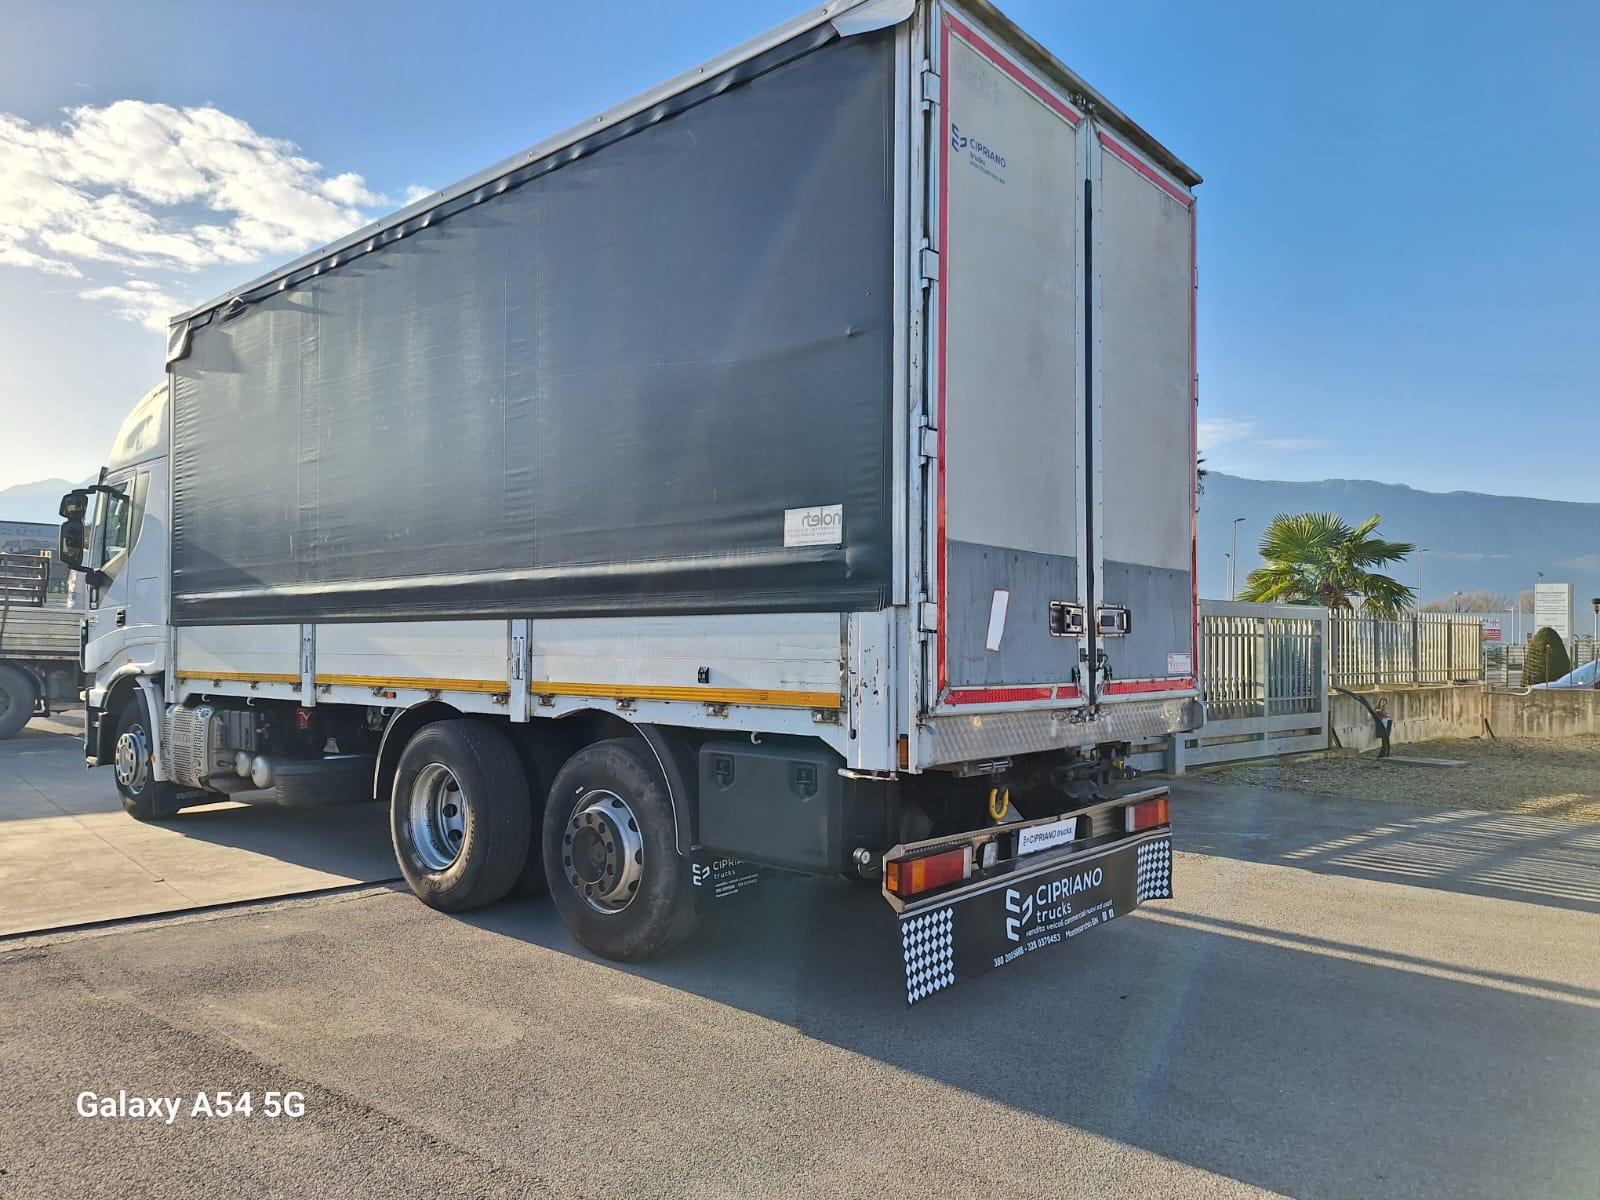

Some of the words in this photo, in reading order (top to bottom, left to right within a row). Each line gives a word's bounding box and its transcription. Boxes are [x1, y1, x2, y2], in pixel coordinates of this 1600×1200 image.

[970, 138, 1006, 168] CIPRIANO
[1029, 830, 1057, 844] CIPRIANO
[1057, 827, 1072, 838] trucks
[713, 858, 745, 870] CIPRIA
[713, 870, 736, 880] trucks
[1036, 867, 1103, 905] CIPRIANO
[1036, 902, 1072, 922] trucks
